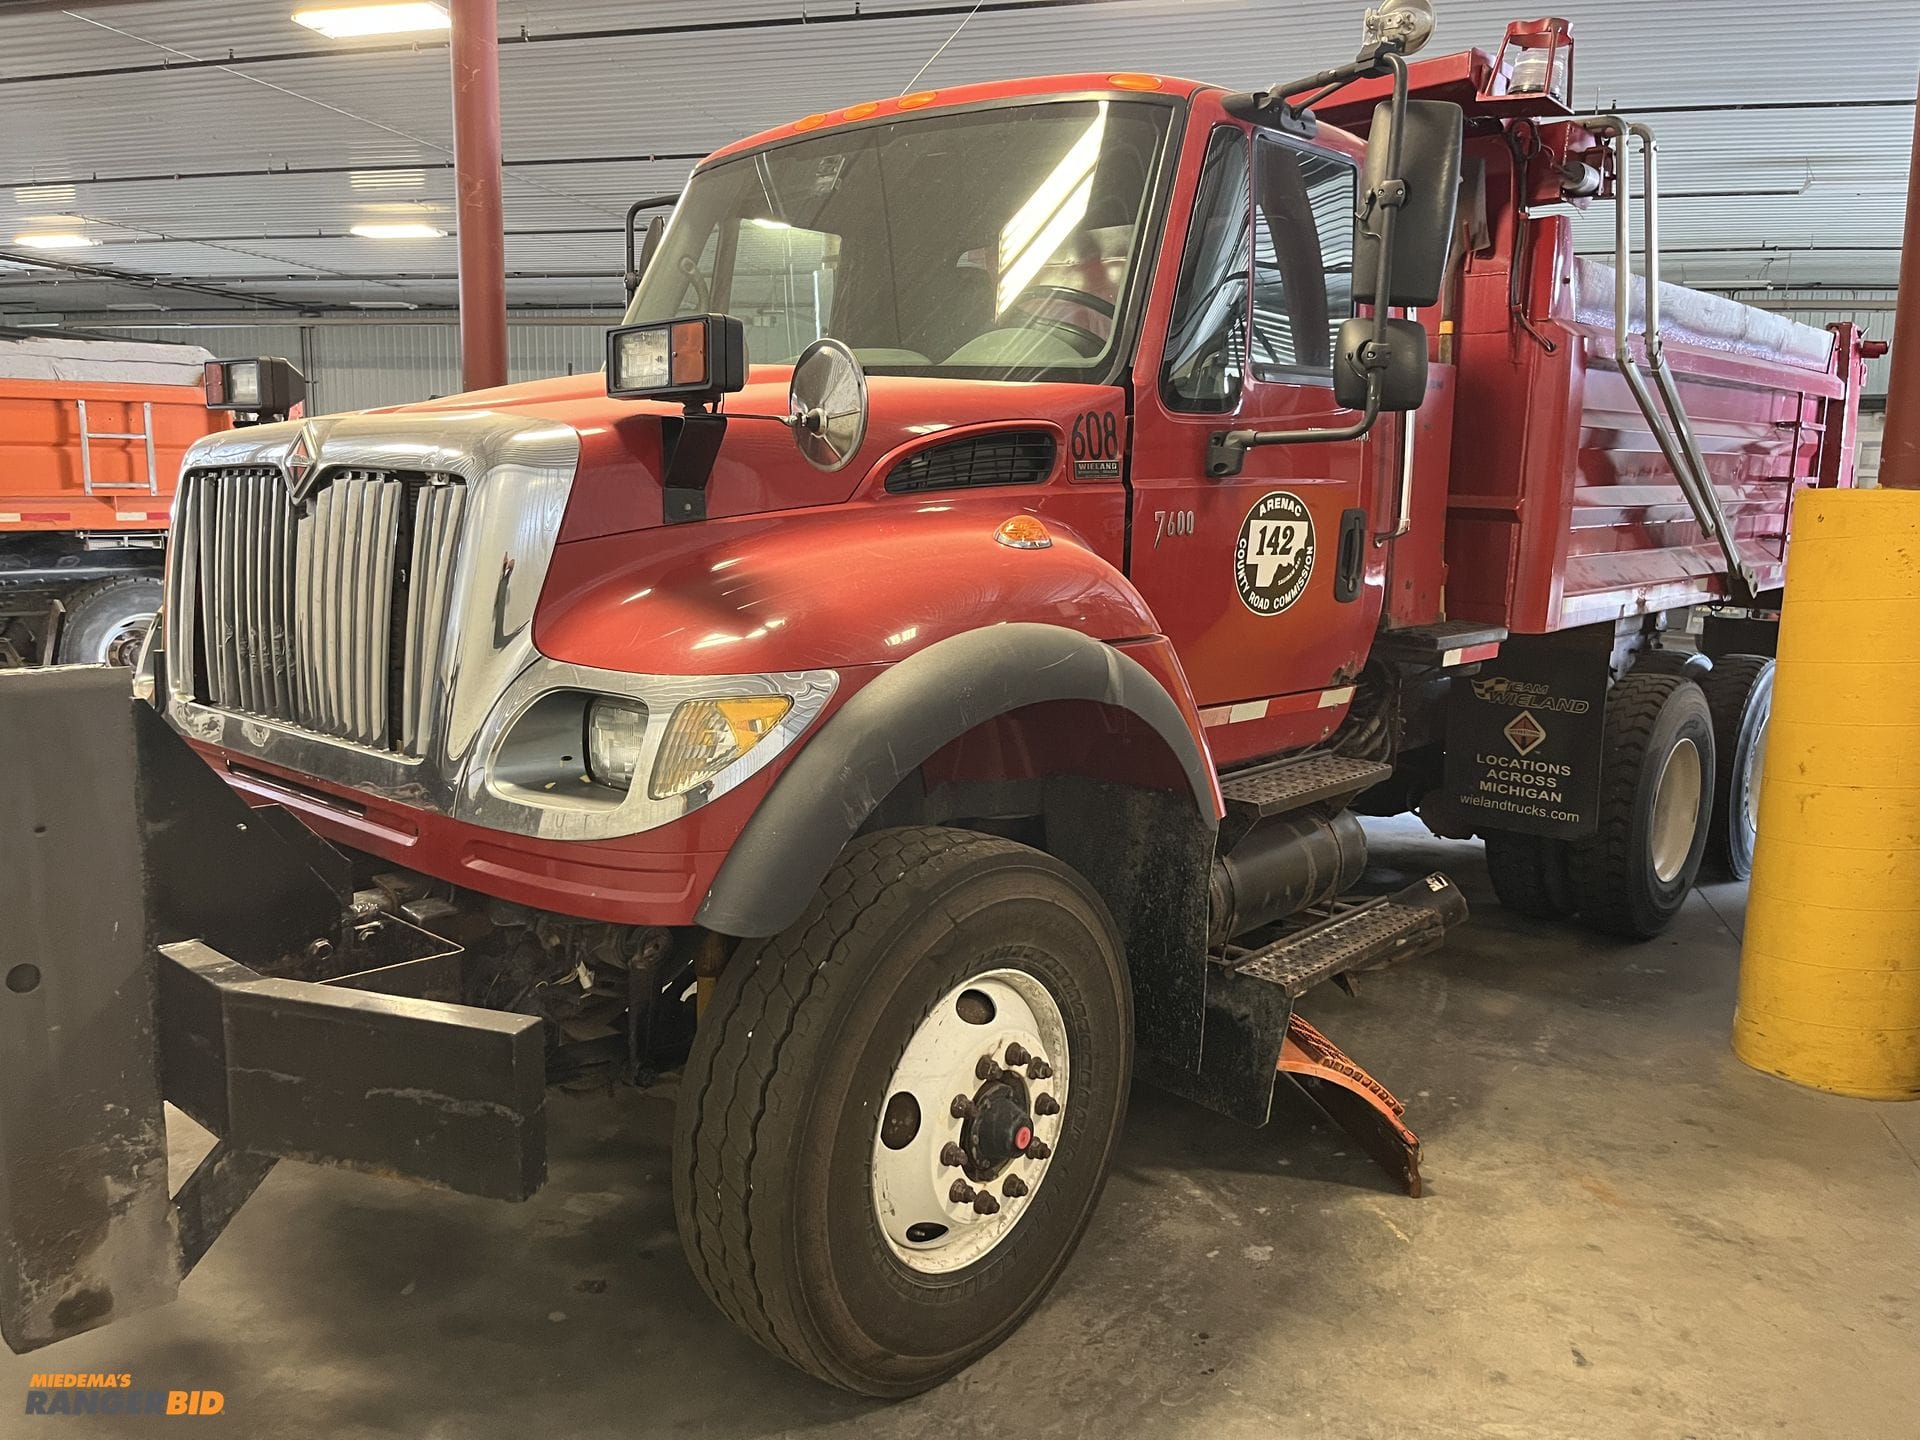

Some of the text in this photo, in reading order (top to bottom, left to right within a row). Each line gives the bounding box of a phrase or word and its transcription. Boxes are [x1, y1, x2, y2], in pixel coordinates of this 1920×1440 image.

[1071, 411, 1118, 460] 608
[1078, 462, 1117, 470] WIELAND
[1259, 497, 1302, 517] ARENAC
[1154, 510, 1194, 549] 7600
[1256, 525, 1295, 556] 142
[1237, 538, 1250, 594] COUNTY
[1248, 591, 1270, 610] ROAD
[1273, 546, 1314, 610] COMMISSION
[1506, 681, 1549, 695] TEAM
[1488, 691, 1590, 714] WIELAND
[1476, 753, 1572, 776] LOCATIONS
[1486, 768, 1557, 788] ACROSS
[1479, 780, 1562, 803] MICHIGAN
[1460, 794, 1580, 823] wielandtrucks.com
